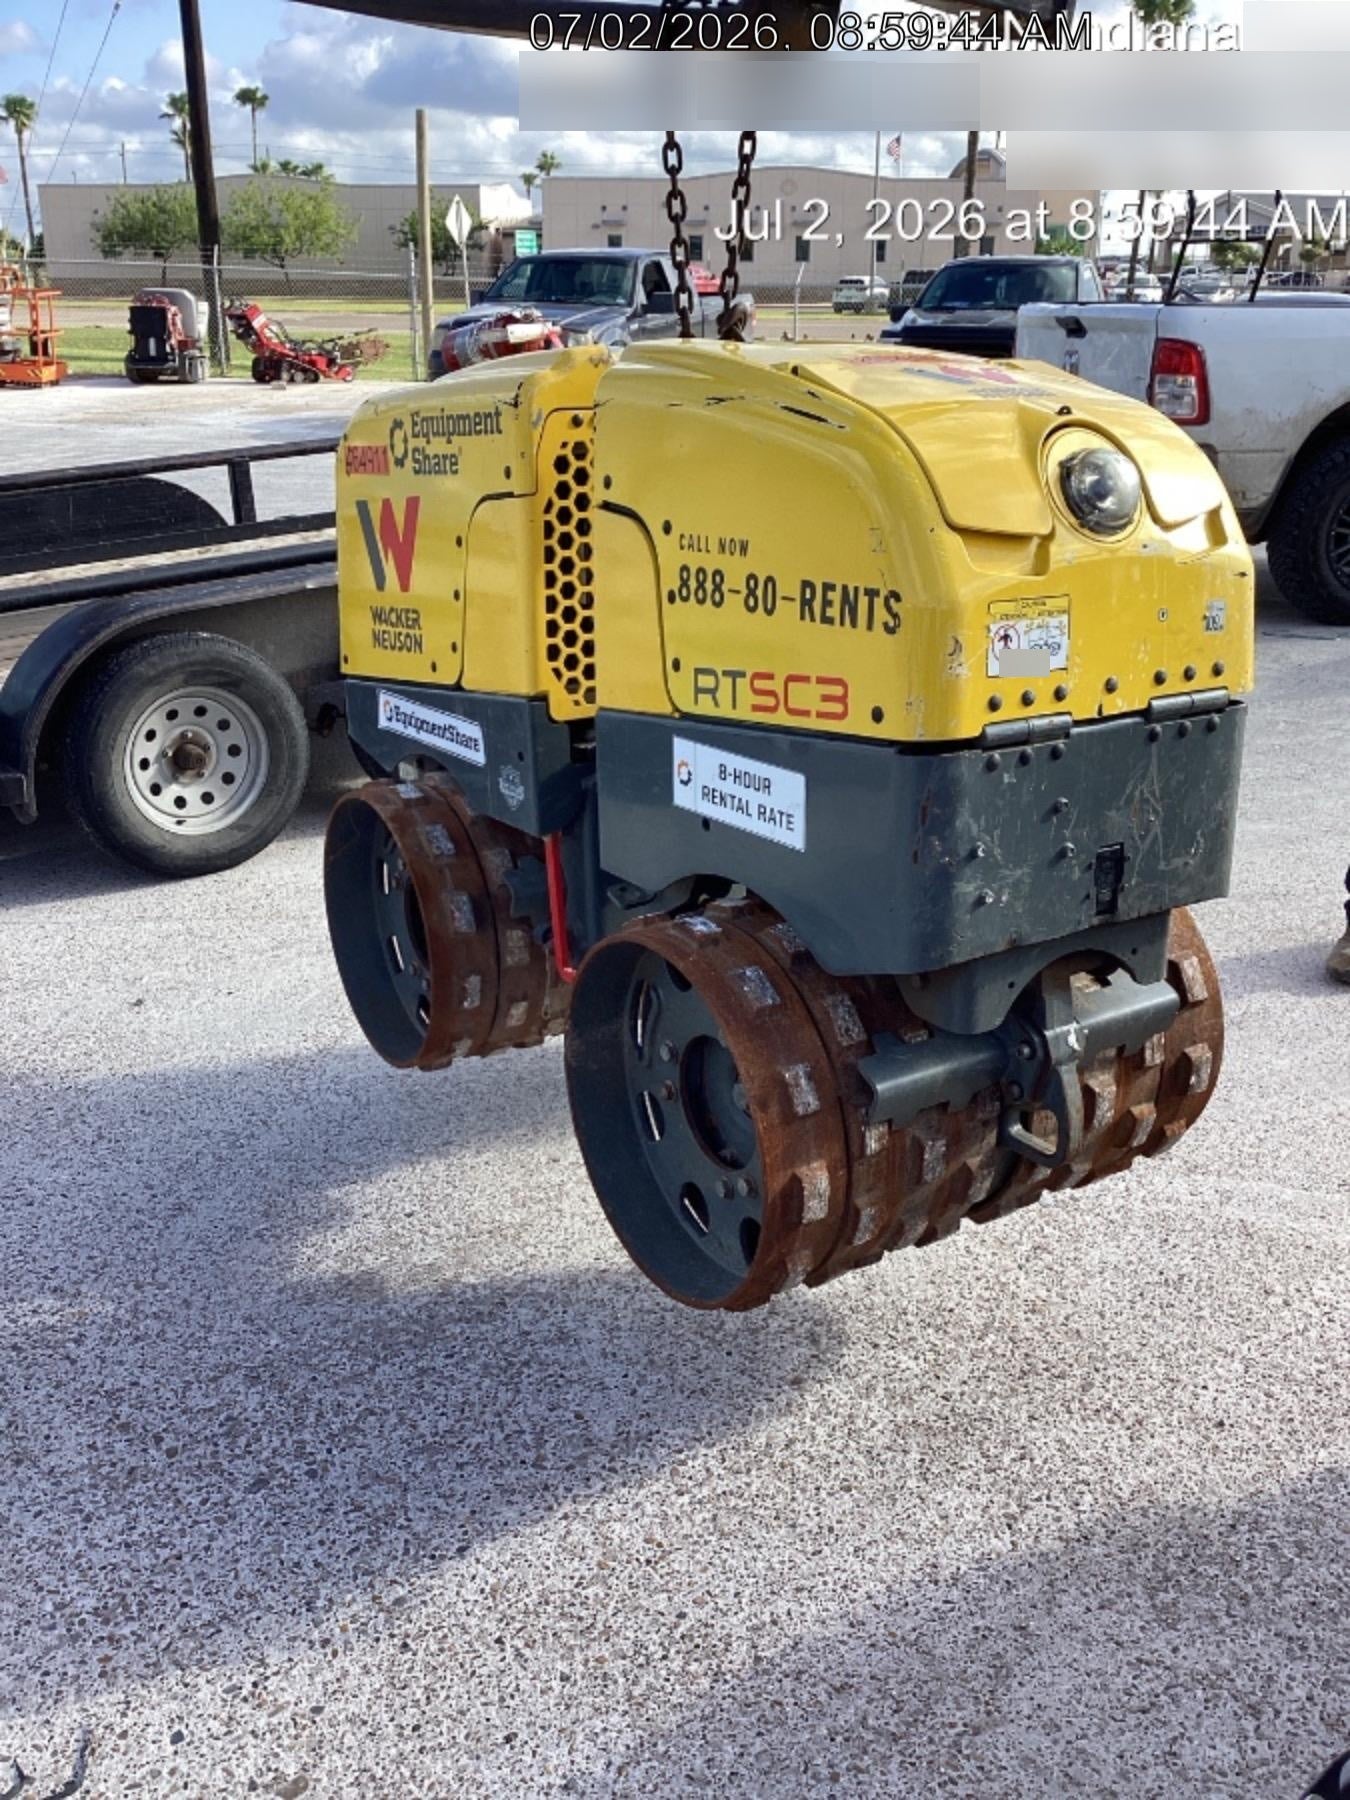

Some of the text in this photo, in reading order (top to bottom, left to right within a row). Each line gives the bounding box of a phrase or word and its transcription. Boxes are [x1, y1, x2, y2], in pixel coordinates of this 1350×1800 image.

[410, 407, 503, 444] Equipment
[412, 447, 459, 475] Share
[679, 533, 750, 558] CALL NOW
[678, 563, 902, 636] 888-80-RENTS
[370, 605, 423, 631] WACKER
[371, 629, 423, 654] NEUSON
[694, 667, 849, 721] RTSC3
[393, 704, 481, 752] EquipmentShare
[718, 763, 771, 796] 8-HOUR
[701, 785, 795, 832] RENTAL RATE
